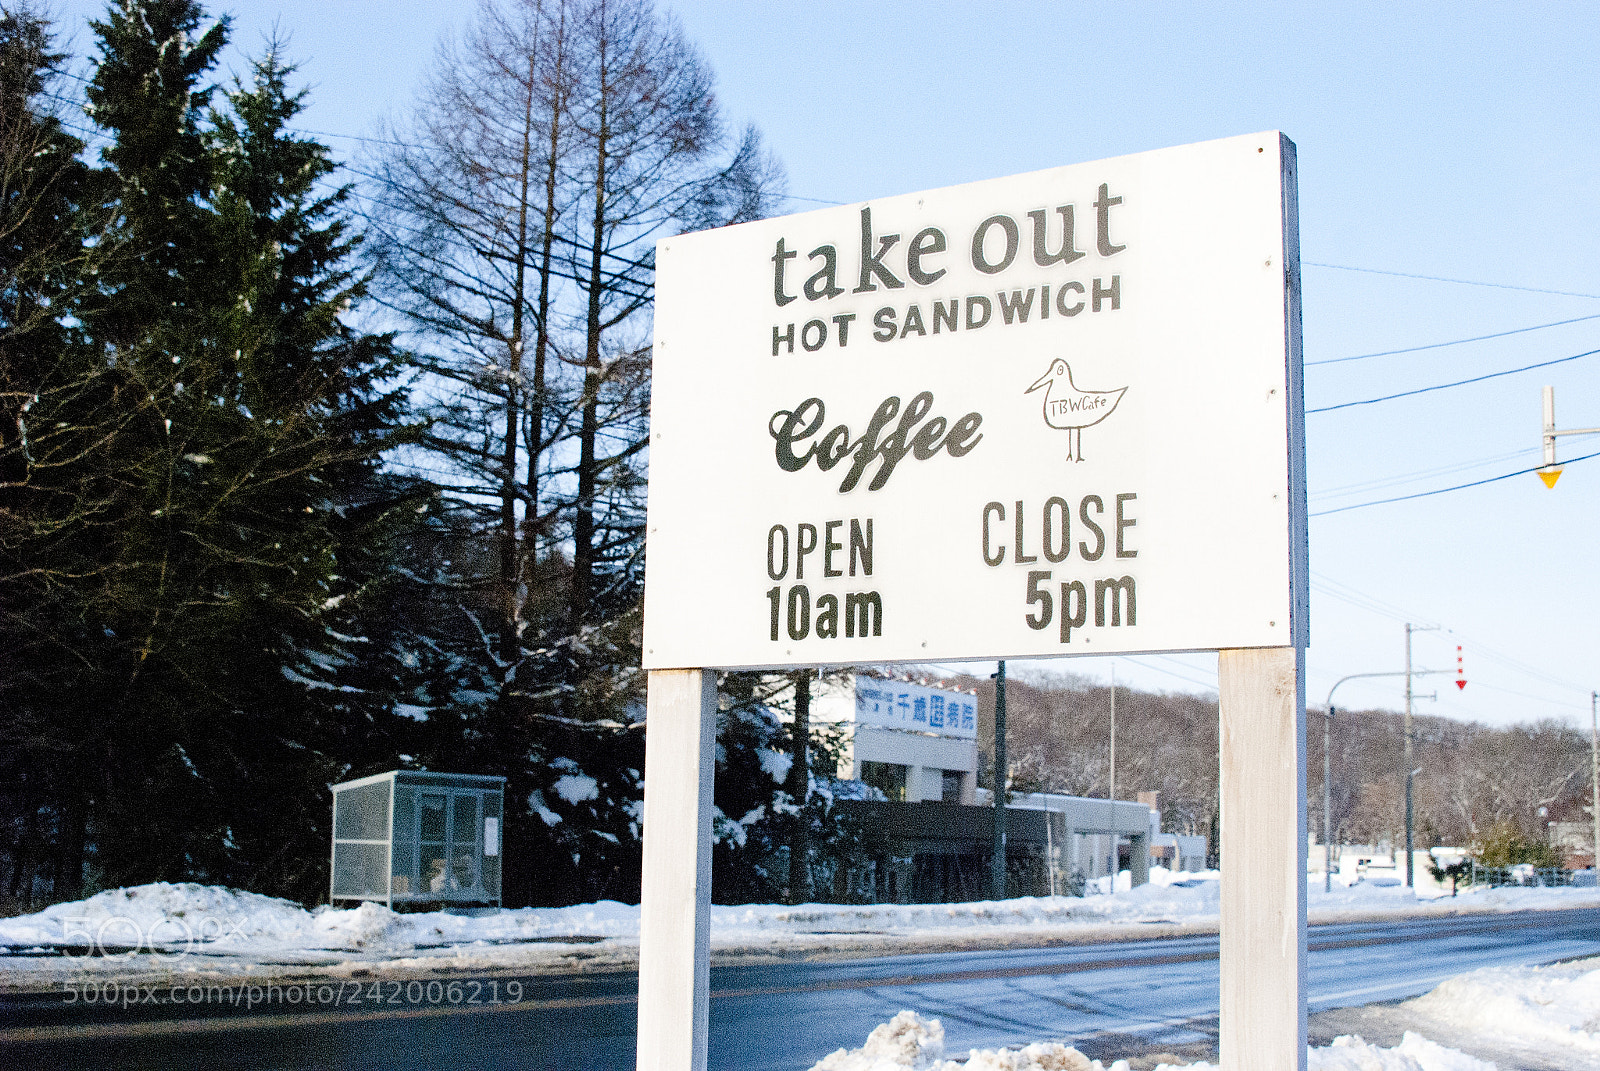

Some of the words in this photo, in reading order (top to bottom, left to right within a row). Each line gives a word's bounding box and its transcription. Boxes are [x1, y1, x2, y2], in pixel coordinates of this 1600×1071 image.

[771, 206, 948, 307] take
[971, 182, 1127, 275] out
[772, 313, 856, 356] HOT
[873, 274, 1121, 343] SANDWICH
[768, 391, 984, 494] Coffee
[767, 518, 874, 582] OPEN
[982, 492, 1138, 568] CLOSE
[766, 585, 883, 642] 10am
[1025, 570, 1138, 644] 5pm
